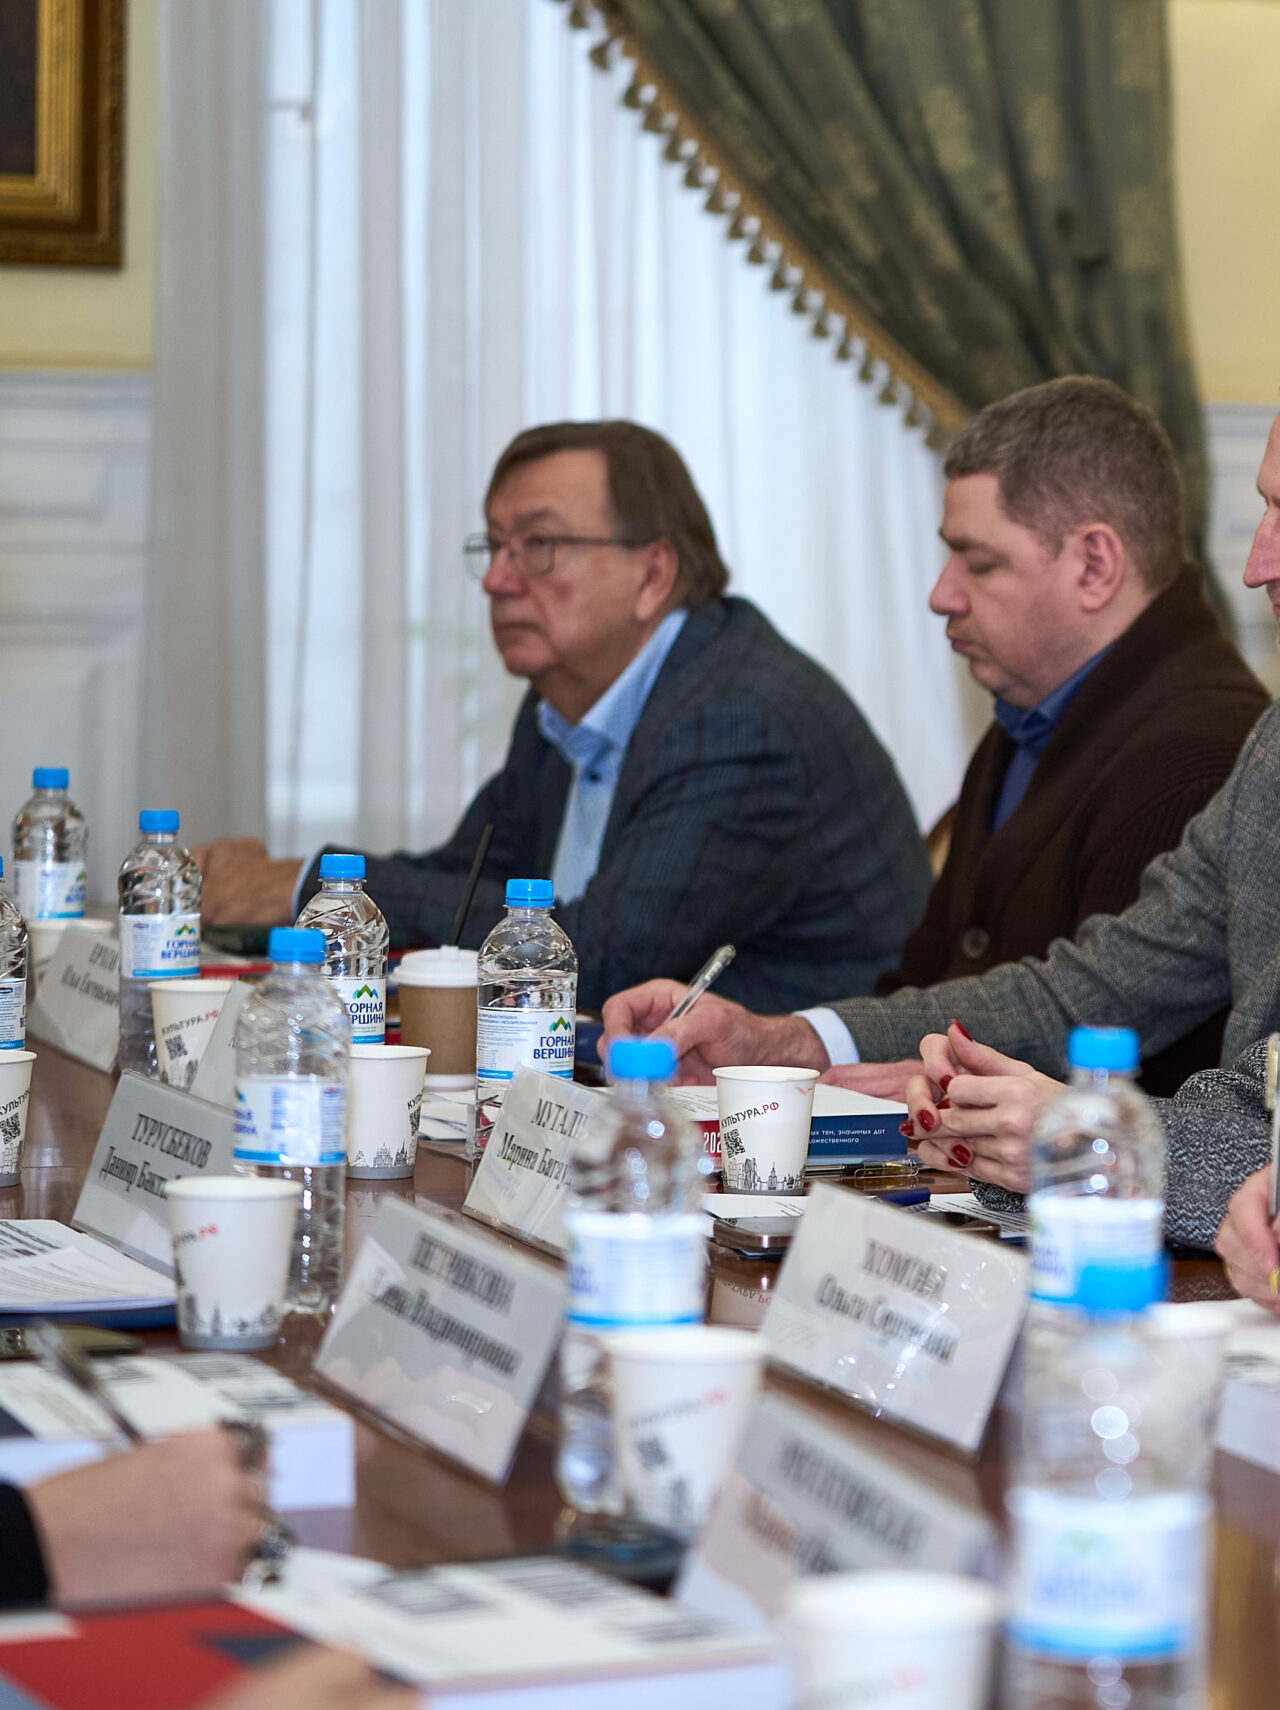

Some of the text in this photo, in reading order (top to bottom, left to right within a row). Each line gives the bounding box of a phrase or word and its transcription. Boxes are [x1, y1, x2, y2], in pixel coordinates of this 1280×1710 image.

[720, 1101, 780, 1129] КУЛЬТУРА.РФ
[131, 1113, 212, 1168] ТУРУСБЕКОВ
[497, 1132, 539, 1171] Марина
[99, 1146, 139, 1193] Данияр
